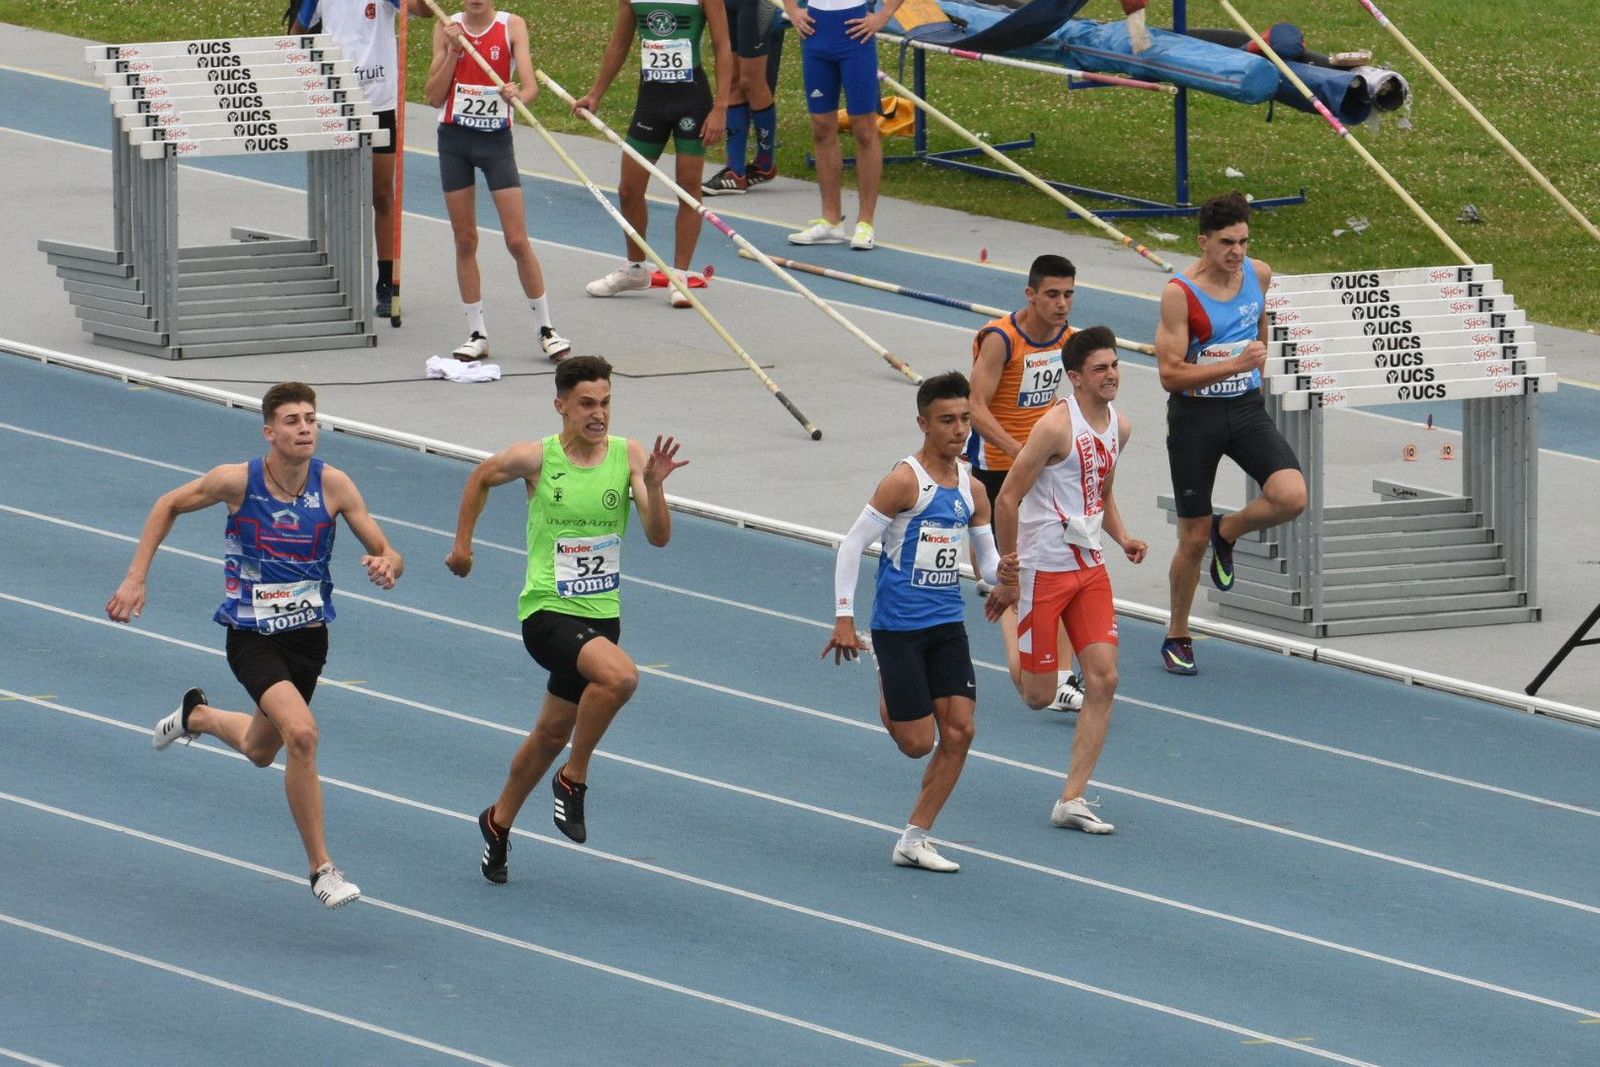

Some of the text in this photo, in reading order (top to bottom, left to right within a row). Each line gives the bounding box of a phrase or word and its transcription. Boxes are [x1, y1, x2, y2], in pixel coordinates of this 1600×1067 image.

[201, 42, 231, 54] UCS
[210, 55, 240, 67] UCS
[650, 53, 683, 68] 236
[221, 69, 251, 80] UCS
[354, 64, 385, 80] fruit
[227, 82, 258, 94] UCS
[233, 96, 262, 108] UCS
[462, 98, 499, 116] 224
[241, 110, 271, 122] UCS
[248, 123, 277, 136] UCS
[258, 138, 288, 151] UCS
[1346, 274, 1380, 288] UCS
[1356, 290, 1390, 304] UCS
[1367, 304, 1400, 319] UCS
[1378, 320, 1412, 334] UCS
[1387, 336, 1421, 350] UCS
[1390, 352, 1424, 367] UCS
[1033, 368, 1062, 390] 194
[1401, 368, 1434, 383] UCS
[1024, 390, 1053, 406] Jom
[1412, 384, 1446, 400] UCS
[1407, 448, 1415, 457] 10
[1443, 446, 1452, 455] 10
[936, 548, 957, 569] 63
[576, 556, 605, 577] 52
